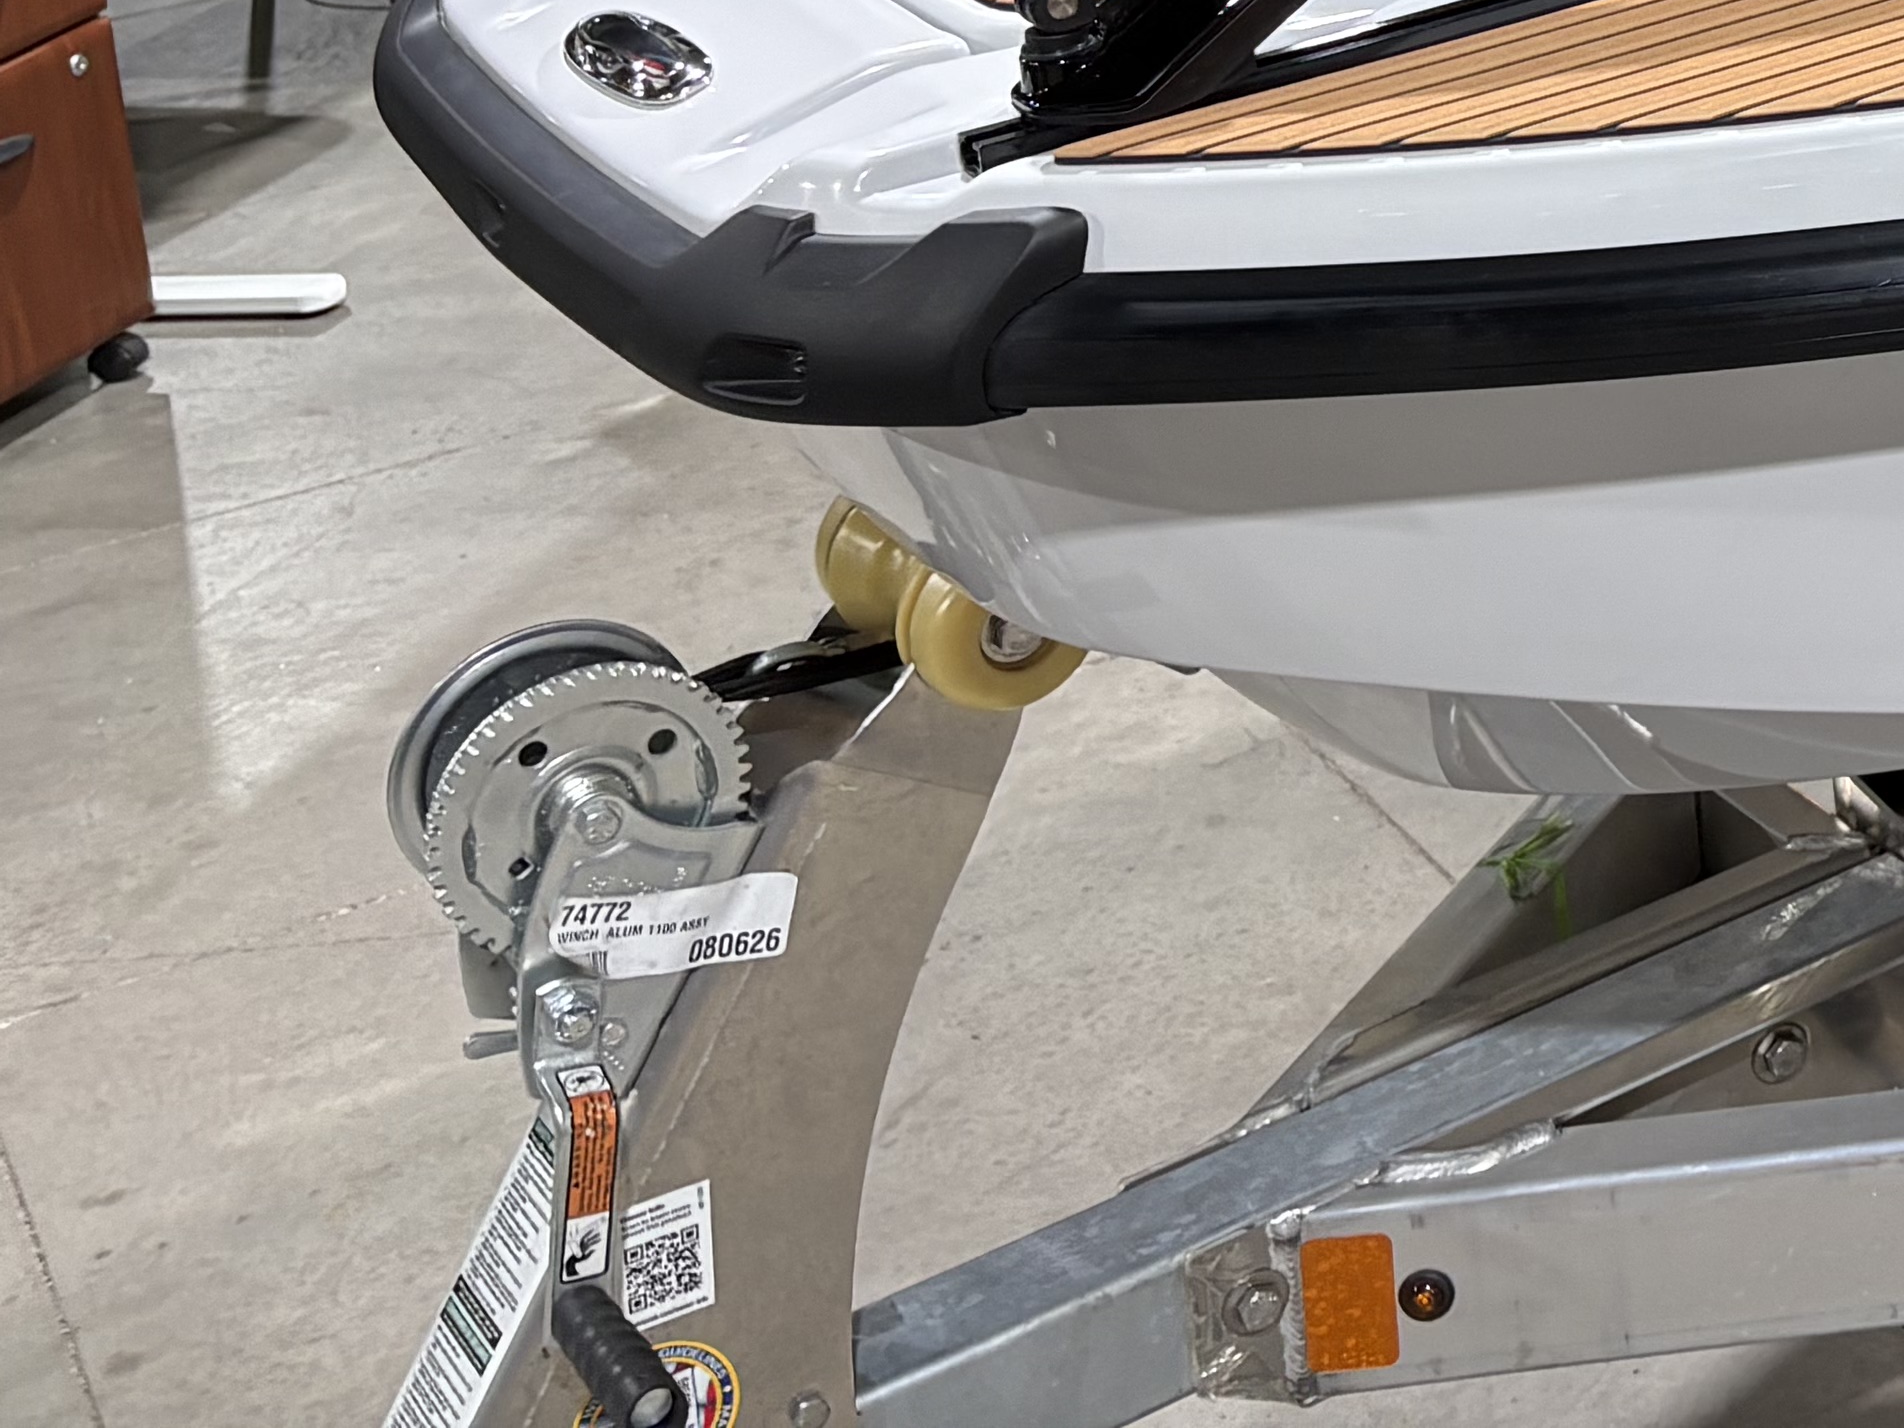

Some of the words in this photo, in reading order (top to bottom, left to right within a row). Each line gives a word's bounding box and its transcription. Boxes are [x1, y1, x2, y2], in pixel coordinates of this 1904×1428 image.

[561, 901, 632, 927] 74772
[557, 928, 599, 945] WINCH
[606, 924, 643, 939] ALUM
[688, 927, 782, 964] 080626
